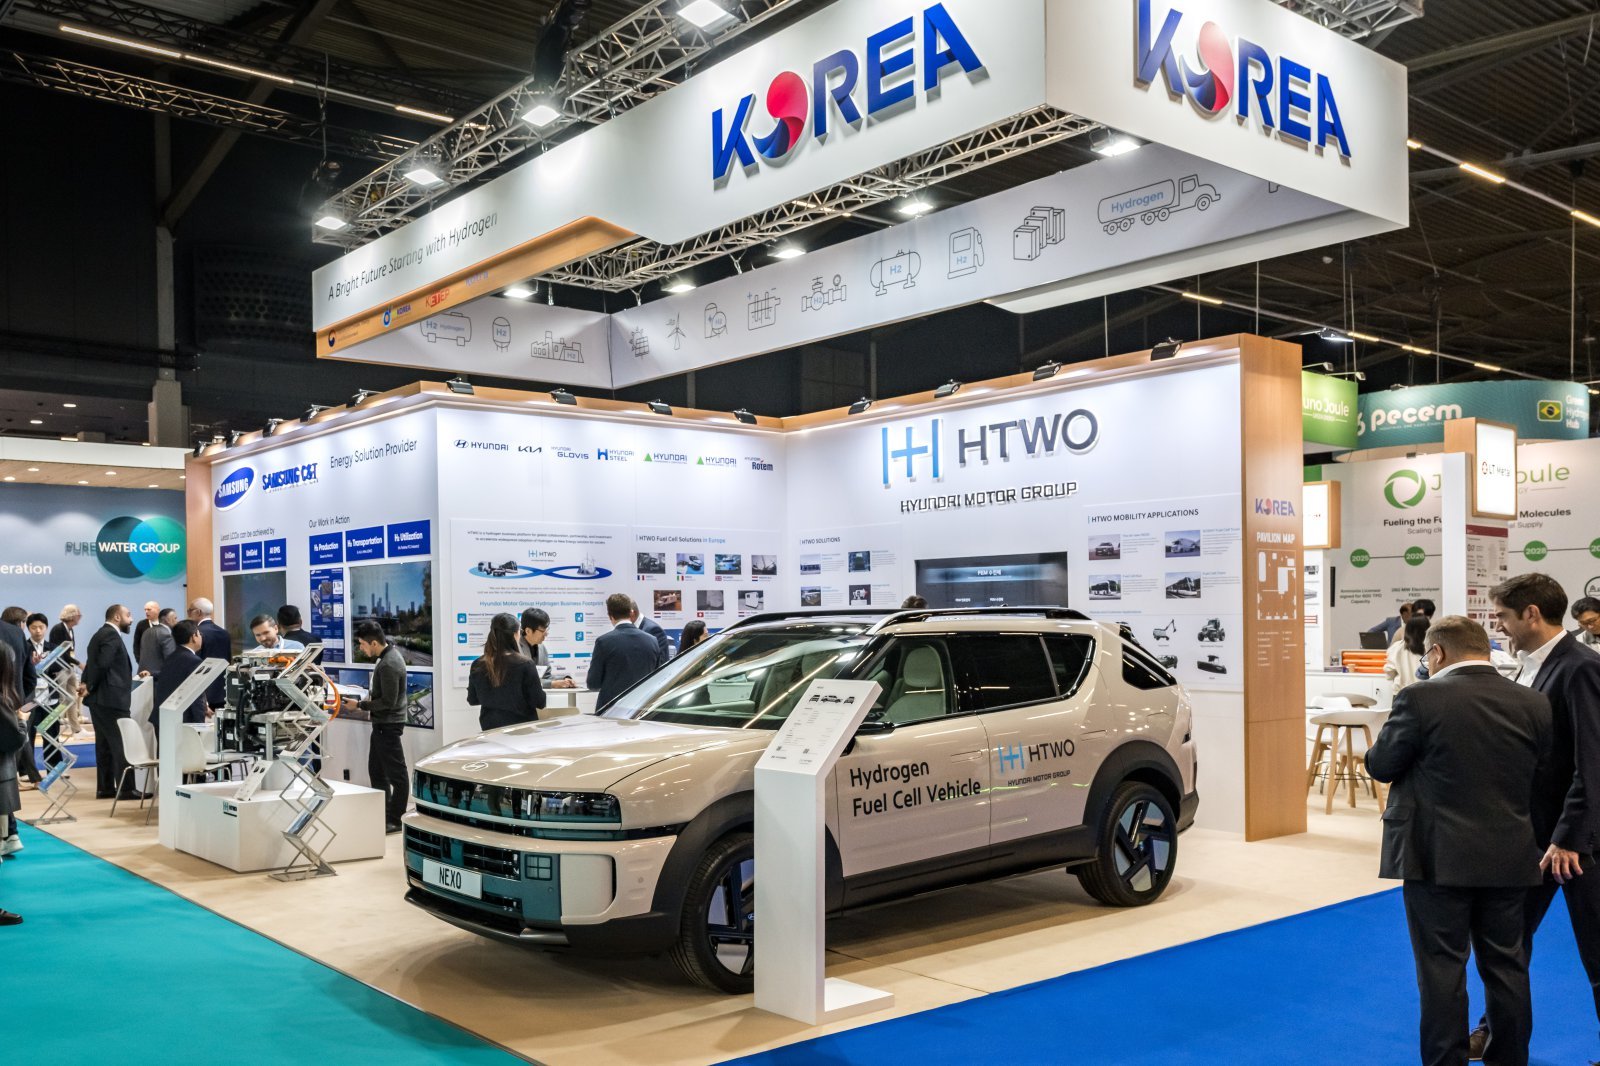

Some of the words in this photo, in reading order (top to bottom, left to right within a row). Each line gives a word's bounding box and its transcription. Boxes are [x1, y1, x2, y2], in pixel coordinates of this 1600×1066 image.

[1136, 0, 1352, 160] KOREA
[711, 2, 988, 183] KOREA
[1111, 190, 1164, 213] Hydrogen
[328, 286, 334, 300] A
[336, 278, 359, 296] Bright
[361, 264, 386, 285] Future
[389, 247, 423, 275] Starting
[426, 233, 446, 256] with
[449, 212, 498, 247] Hydrogen
[956, 256, 968, 265] H2
[890, 264, 902, 274] H2
[426, 320, 437, 330] H2
[496, 328, 507, 337] H2
[958, 408, 1100, 467] HTWO
[471, 442, 509, 450] HYUNDAI
[330, 453, 353, 469] Energy
[354, 444, 384, 462] Solution
[386, 439, 417, 456] Provider
[557, 452, 589, 460] GLOVIS
[654, 453, 688, 461] HYUNDAI
[706, 457, 736, 465] HYUNDAI
[752, 461, 773, 471] Rotem
[262, 468, 299, 491] SAMSUNG
[301, 463, 318, 482] C&T
[218, 478, 249, 498] SAMSUNG
[900, 494, 961, 514] HYUNDAI
[965, 489, 1016, 507] MOTOR
[1021, 482, 1077, 500] GROUP
[1255, 498, 1295, 516] KOREA
[1114, 513, 1146, 521] MOBILITY
[1147, 509, 1198, 518] APPLICATIONS
[1520, 509, 1571, 518] Molecules
[335, 516, 350, 524] Action
[353, 536, 382, 547] Transportation
[400, 532, 423, 541] Utilization
[1257, 532, 1281, 542] PAVILION
[1283, 534, 1295, 544] MAP
[98, 542, 137, 553] WATER
[139, 543, 180, 553] GROUP
[319, 542, 338, 551] Production
[0, 563, 52, 575] eration
[1028, 739, 1075, 762] HTWO
[850, 759, 930, 790] Hydrogen
[1008, 777, 1032, 786] HYUNDAI
[1033, 773, 1052, 782] MOTOR
[1053, 770, 1071, 779] GROUP
[852, 794, 887, 817] Fuel
[893, 789, 922, 810] Cell
[926, 778, 982, 802] Vehicle
[439, 866, 462, 890] NEXO
